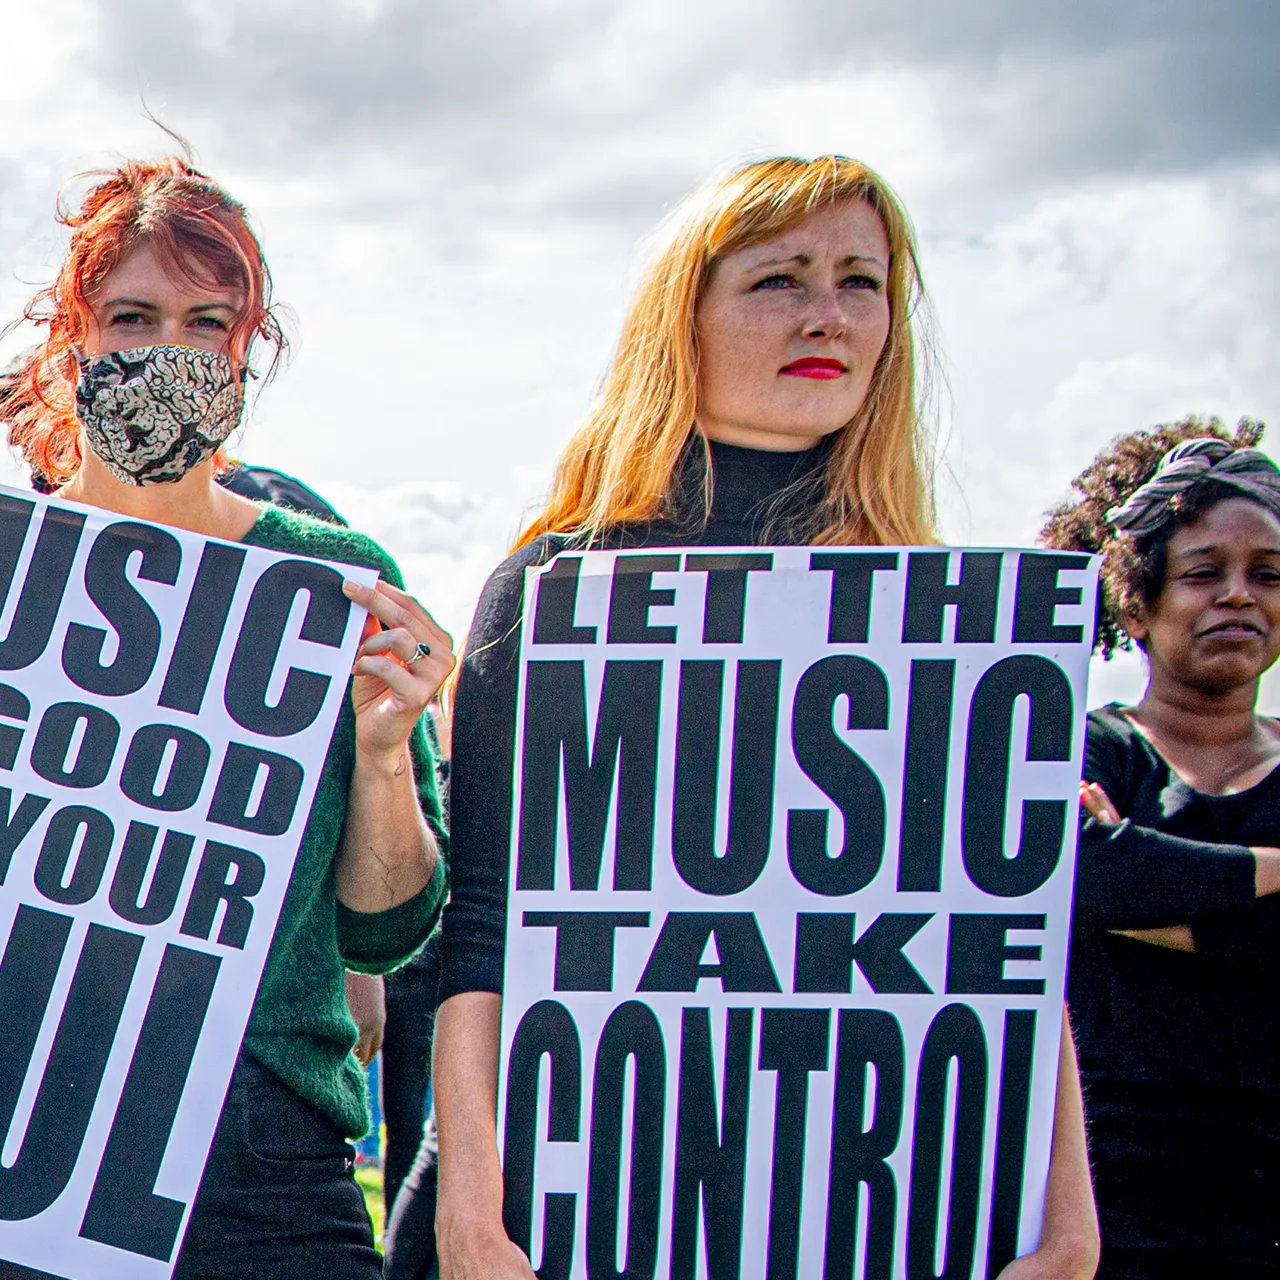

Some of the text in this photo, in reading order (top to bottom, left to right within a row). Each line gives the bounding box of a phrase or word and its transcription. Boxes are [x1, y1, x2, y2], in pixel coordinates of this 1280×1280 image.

[532, 552, 1092, 645] LET THE
[516, 654, 1075, 898] MUSIC
[521, 910, 1048, 996] TAKE
